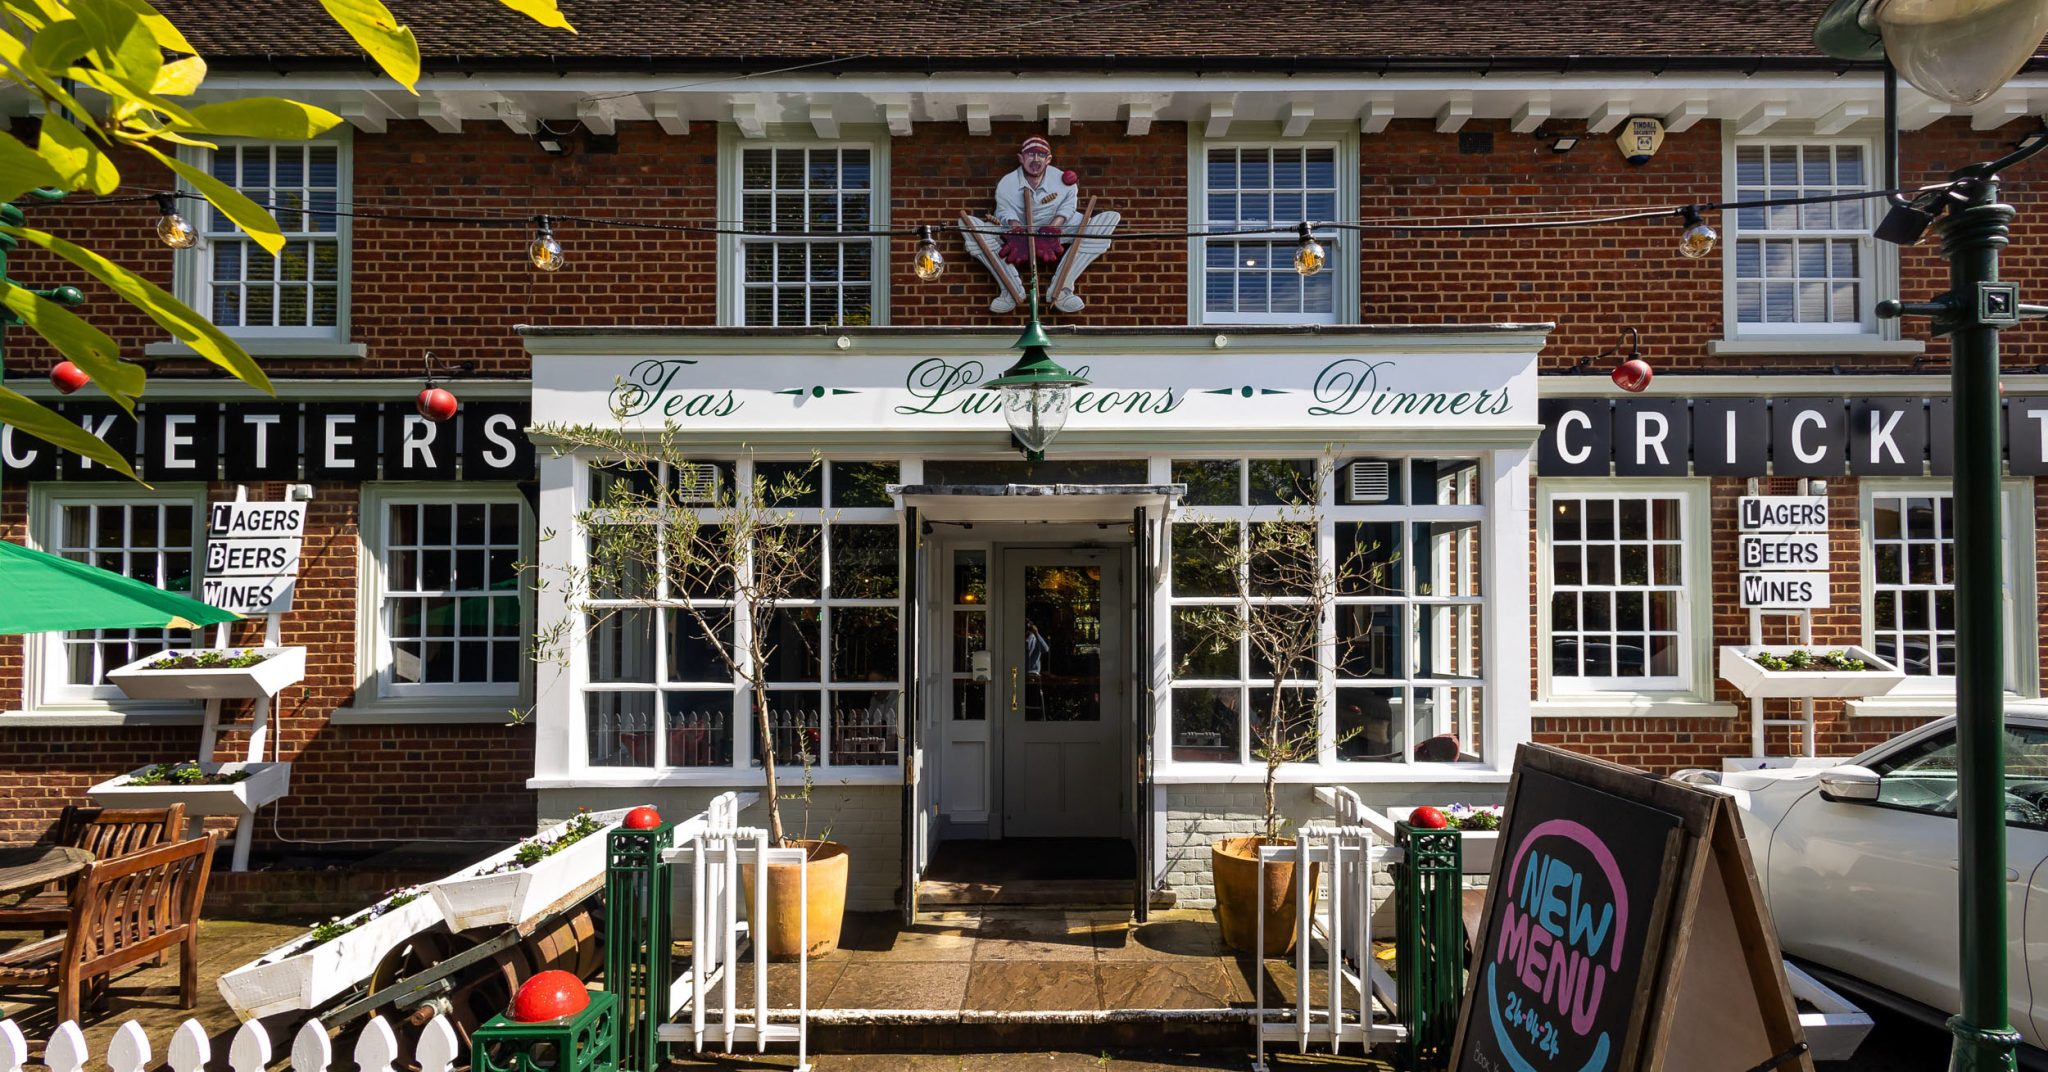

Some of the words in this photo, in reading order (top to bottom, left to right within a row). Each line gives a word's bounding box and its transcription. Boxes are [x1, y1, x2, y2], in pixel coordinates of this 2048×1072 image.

[608, 359, 745, 417] Teas
[894, 357, 1185, 415] Lueons
[1307, 358, 1514, 416] Dinners
[1556, 409, 2048, 465] CRICKT
[213, 508, 300, 531] LAGERS
[1746, 503, 1826, 526] LAGERS
[207, 546, 287, 569] BEERS
[1747, 542, 1819, 564] BEERS
[203, 585, 274, 607] WINES
[1746, 580, 1813, 603] WINES
[1520, 850, 1613, 957] NEW
[1497, 901, 1606, 1036] MENU
